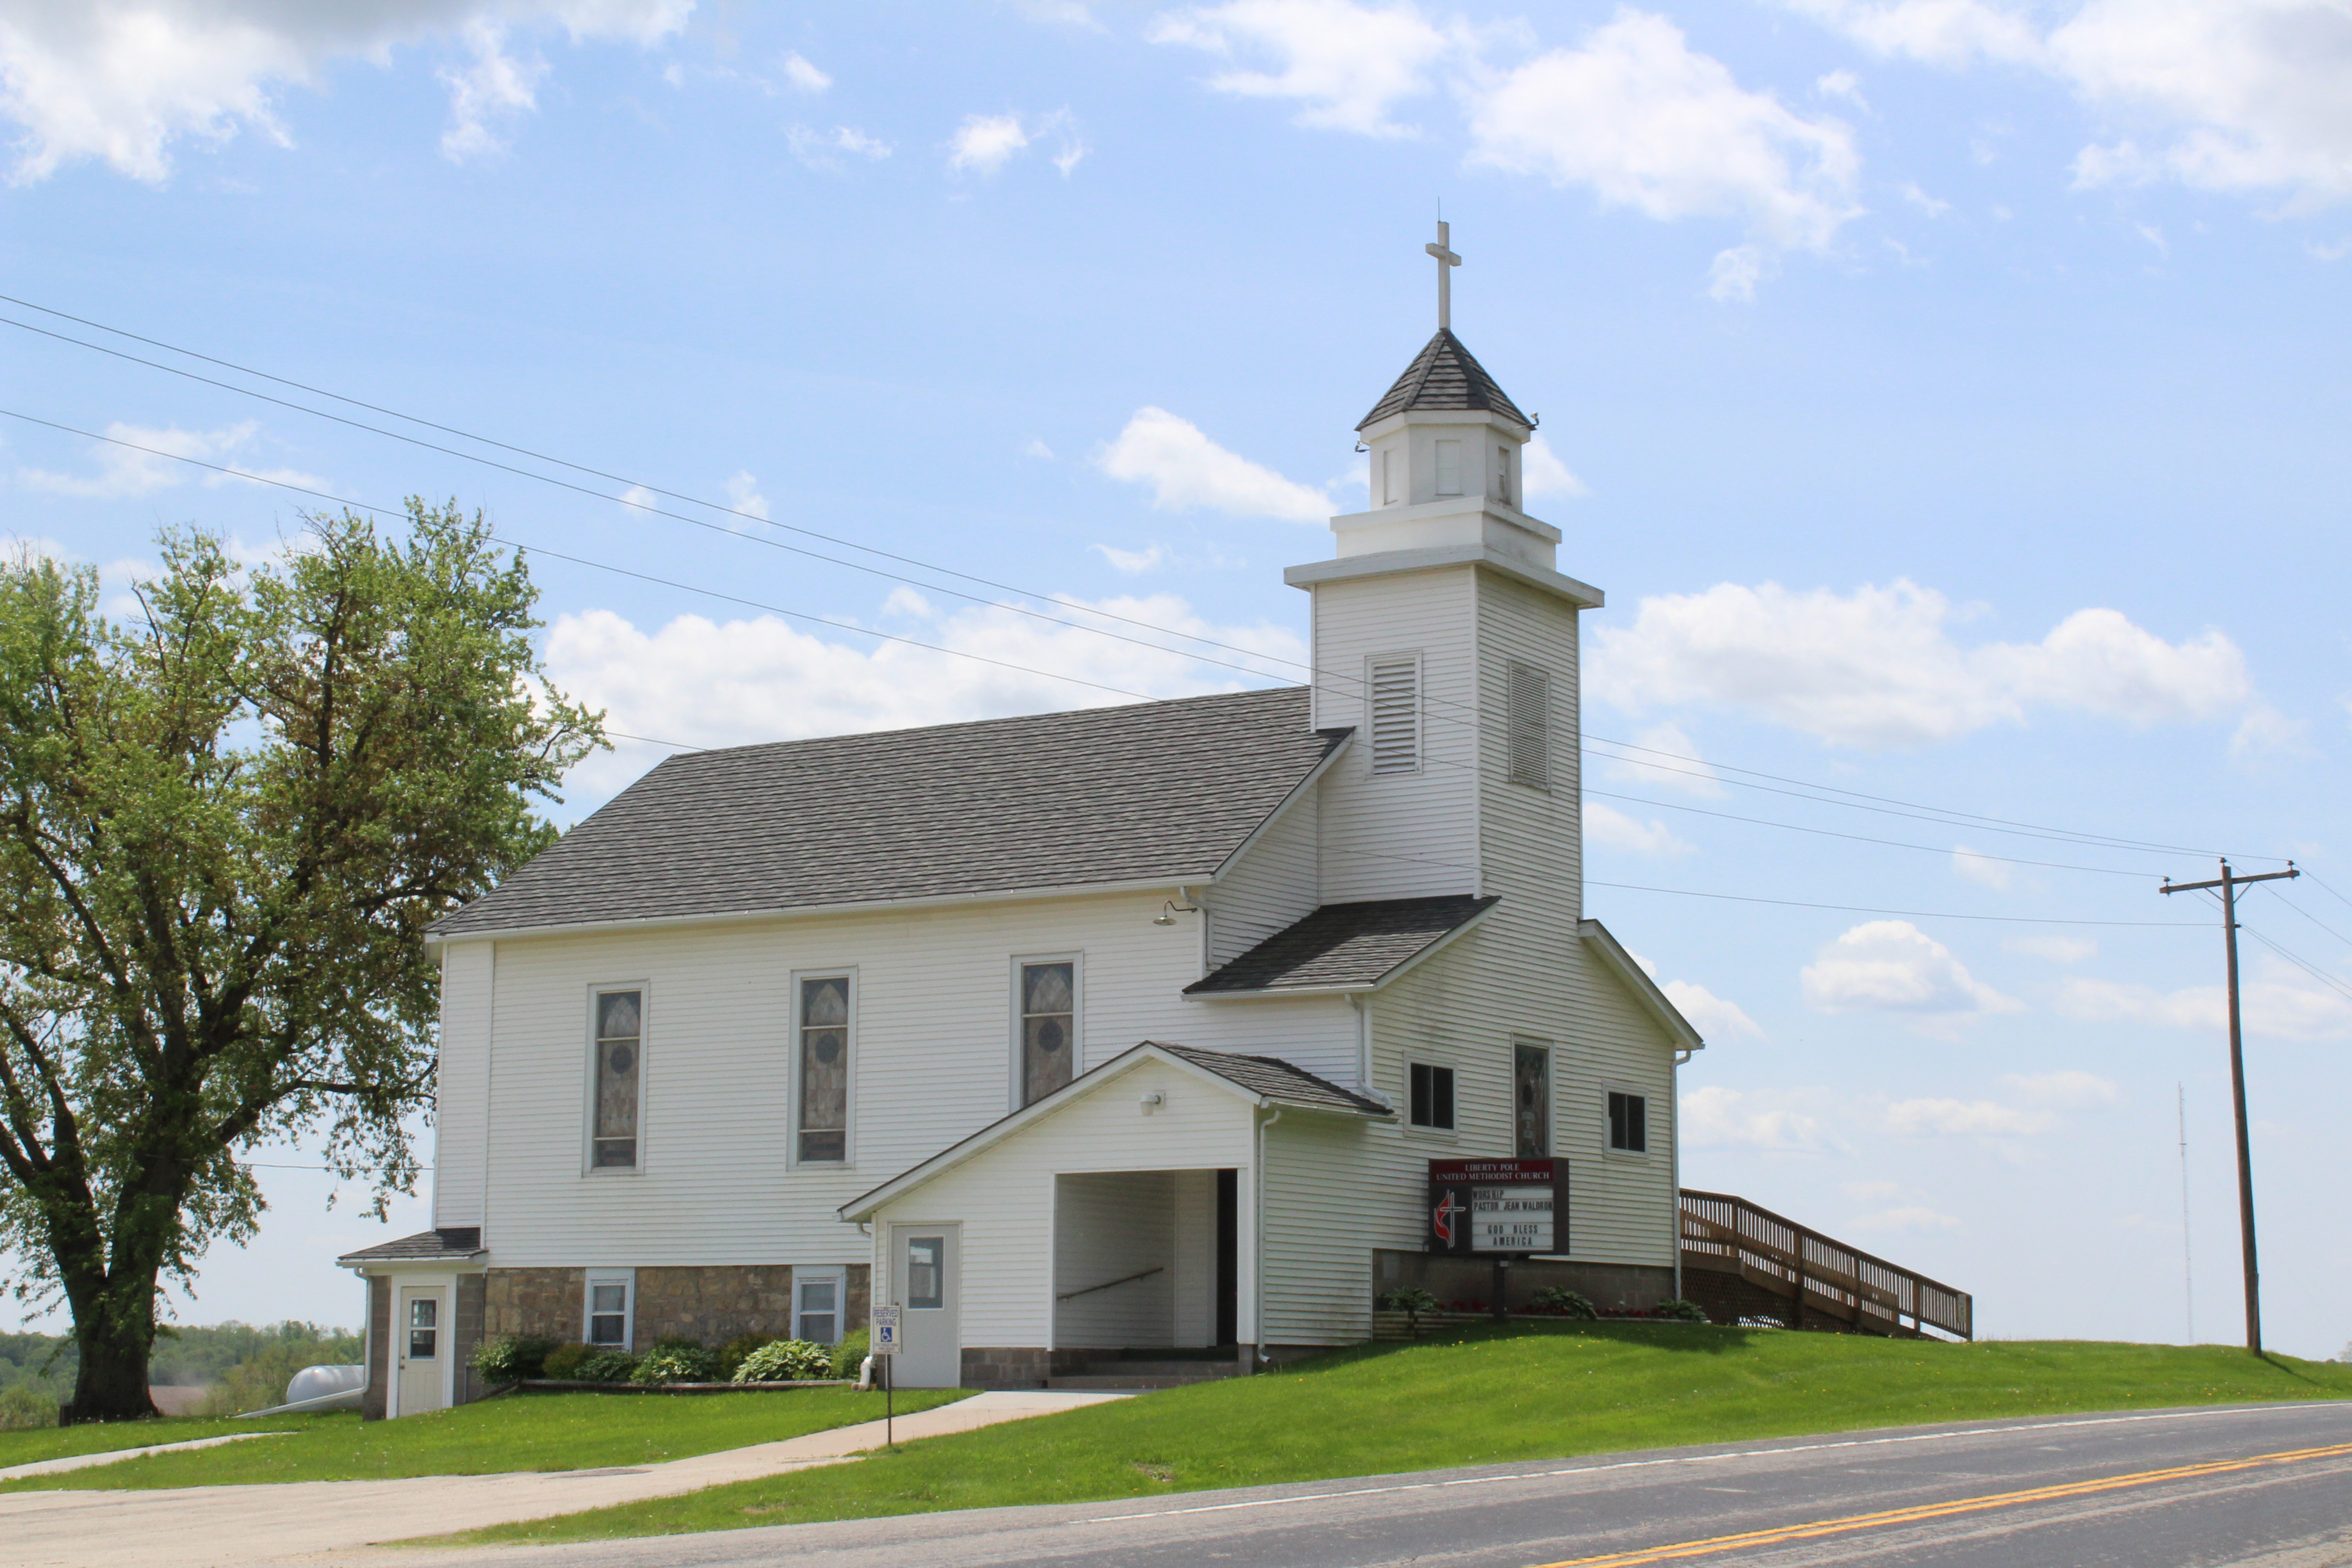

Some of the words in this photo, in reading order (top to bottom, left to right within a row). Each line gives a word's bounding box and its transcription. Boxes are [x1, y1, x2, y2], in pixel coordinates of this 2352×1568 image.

[1472, 1190, 1504, 1199] WORSHIP
[1474, 1202, 1499, 1211] PASTOR
[1504, 1201, 1519, 1210] JEAN
[1522, 1201, 1553, 1210] WALDRON
[1488, 1225, 1503, 1234] GOD
[1513, 1225, 1538, 1234] BLESS
[1493, 1237, 1532, 1246] AMERICA
[874, 1309, 898, 1318] RESERVED
[876, 1318, 897, 1326] PARKING
